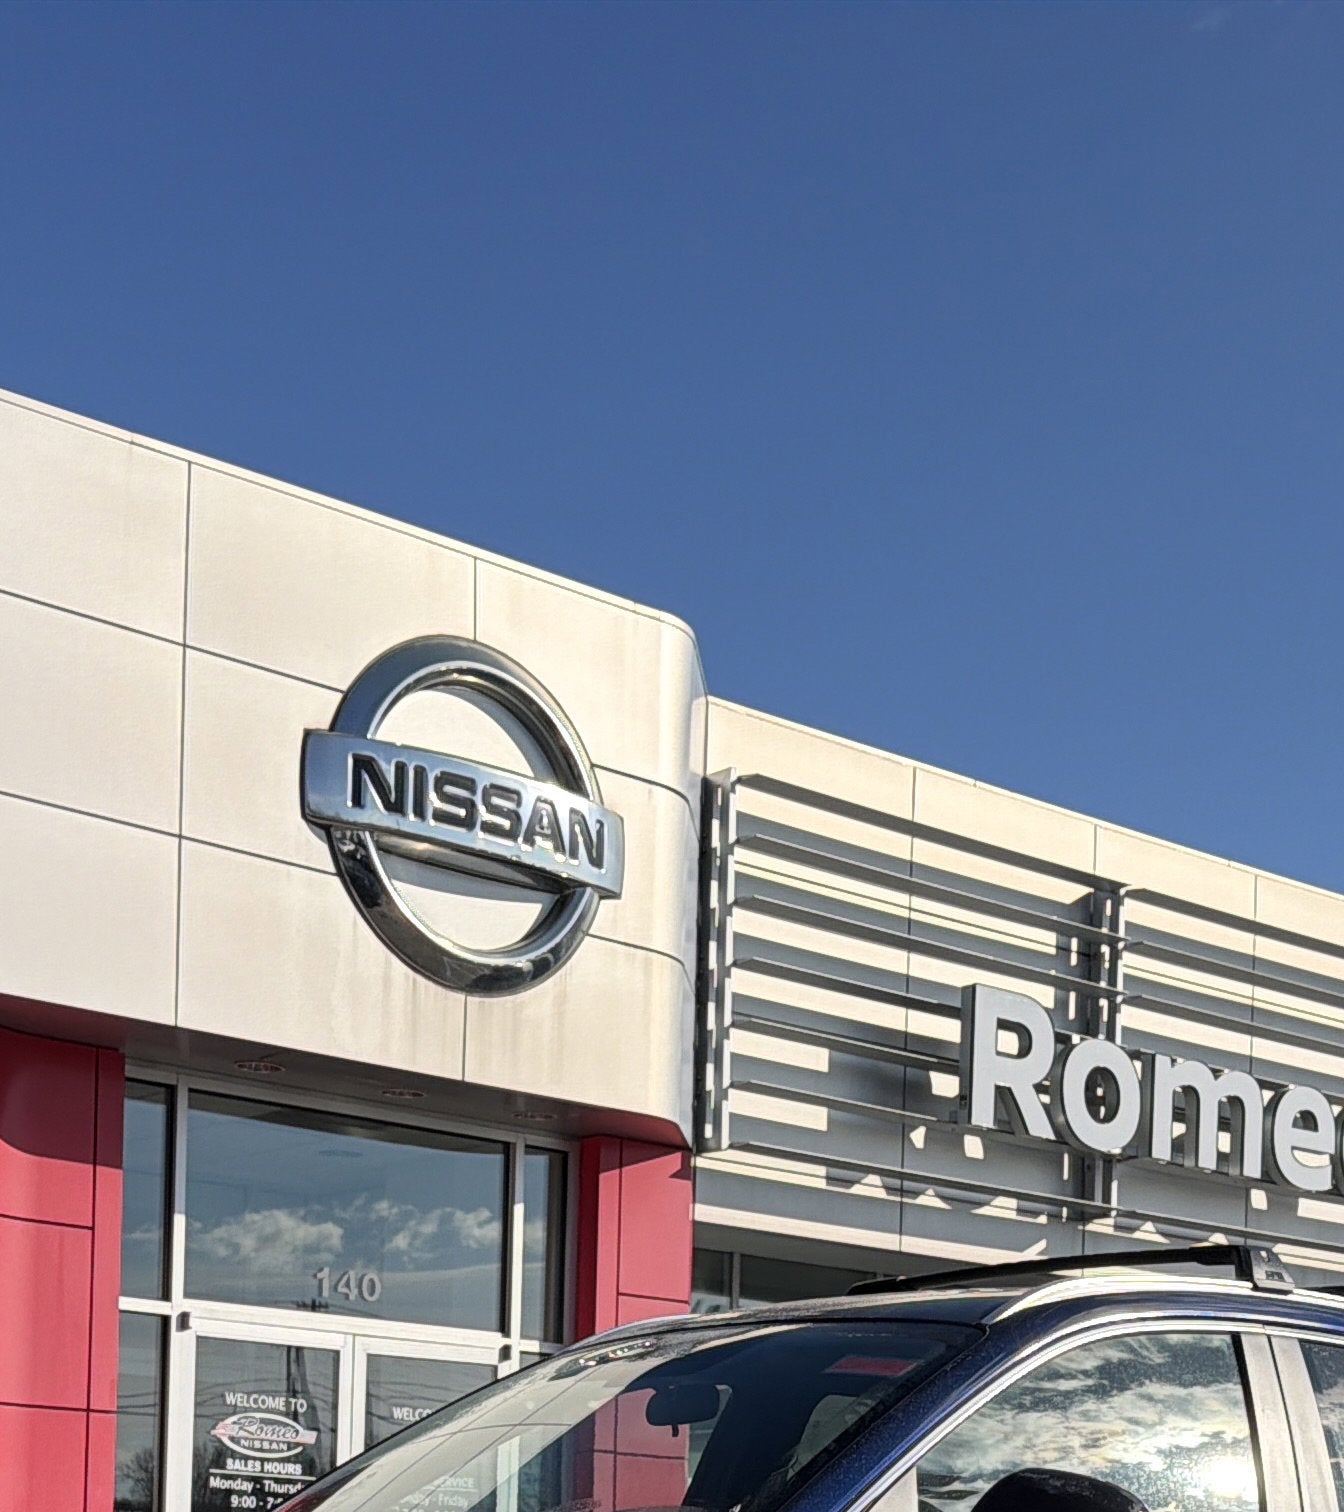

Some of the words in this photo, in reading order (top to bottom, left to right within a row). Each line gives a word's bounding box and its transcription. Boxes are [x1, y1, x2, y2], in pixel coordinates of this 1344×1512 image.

[348, 752, 605, 873] NISSAN
[313, 1267, 381, 1302] 140
[225, 1392, 286, 1411] WELCOME
[289, 1397, 307, 1413] TO
[232, 1416, 300, 1440] Romeo
[240, 1438, 287, 1451] NISSAN
[226, 1458, 261, 1472] SALES
[264, 1461, 302, 1475] HOURS
[209, 1476, 254, 1493] Monday
[231, 1495, 256, 1509] 9:00
